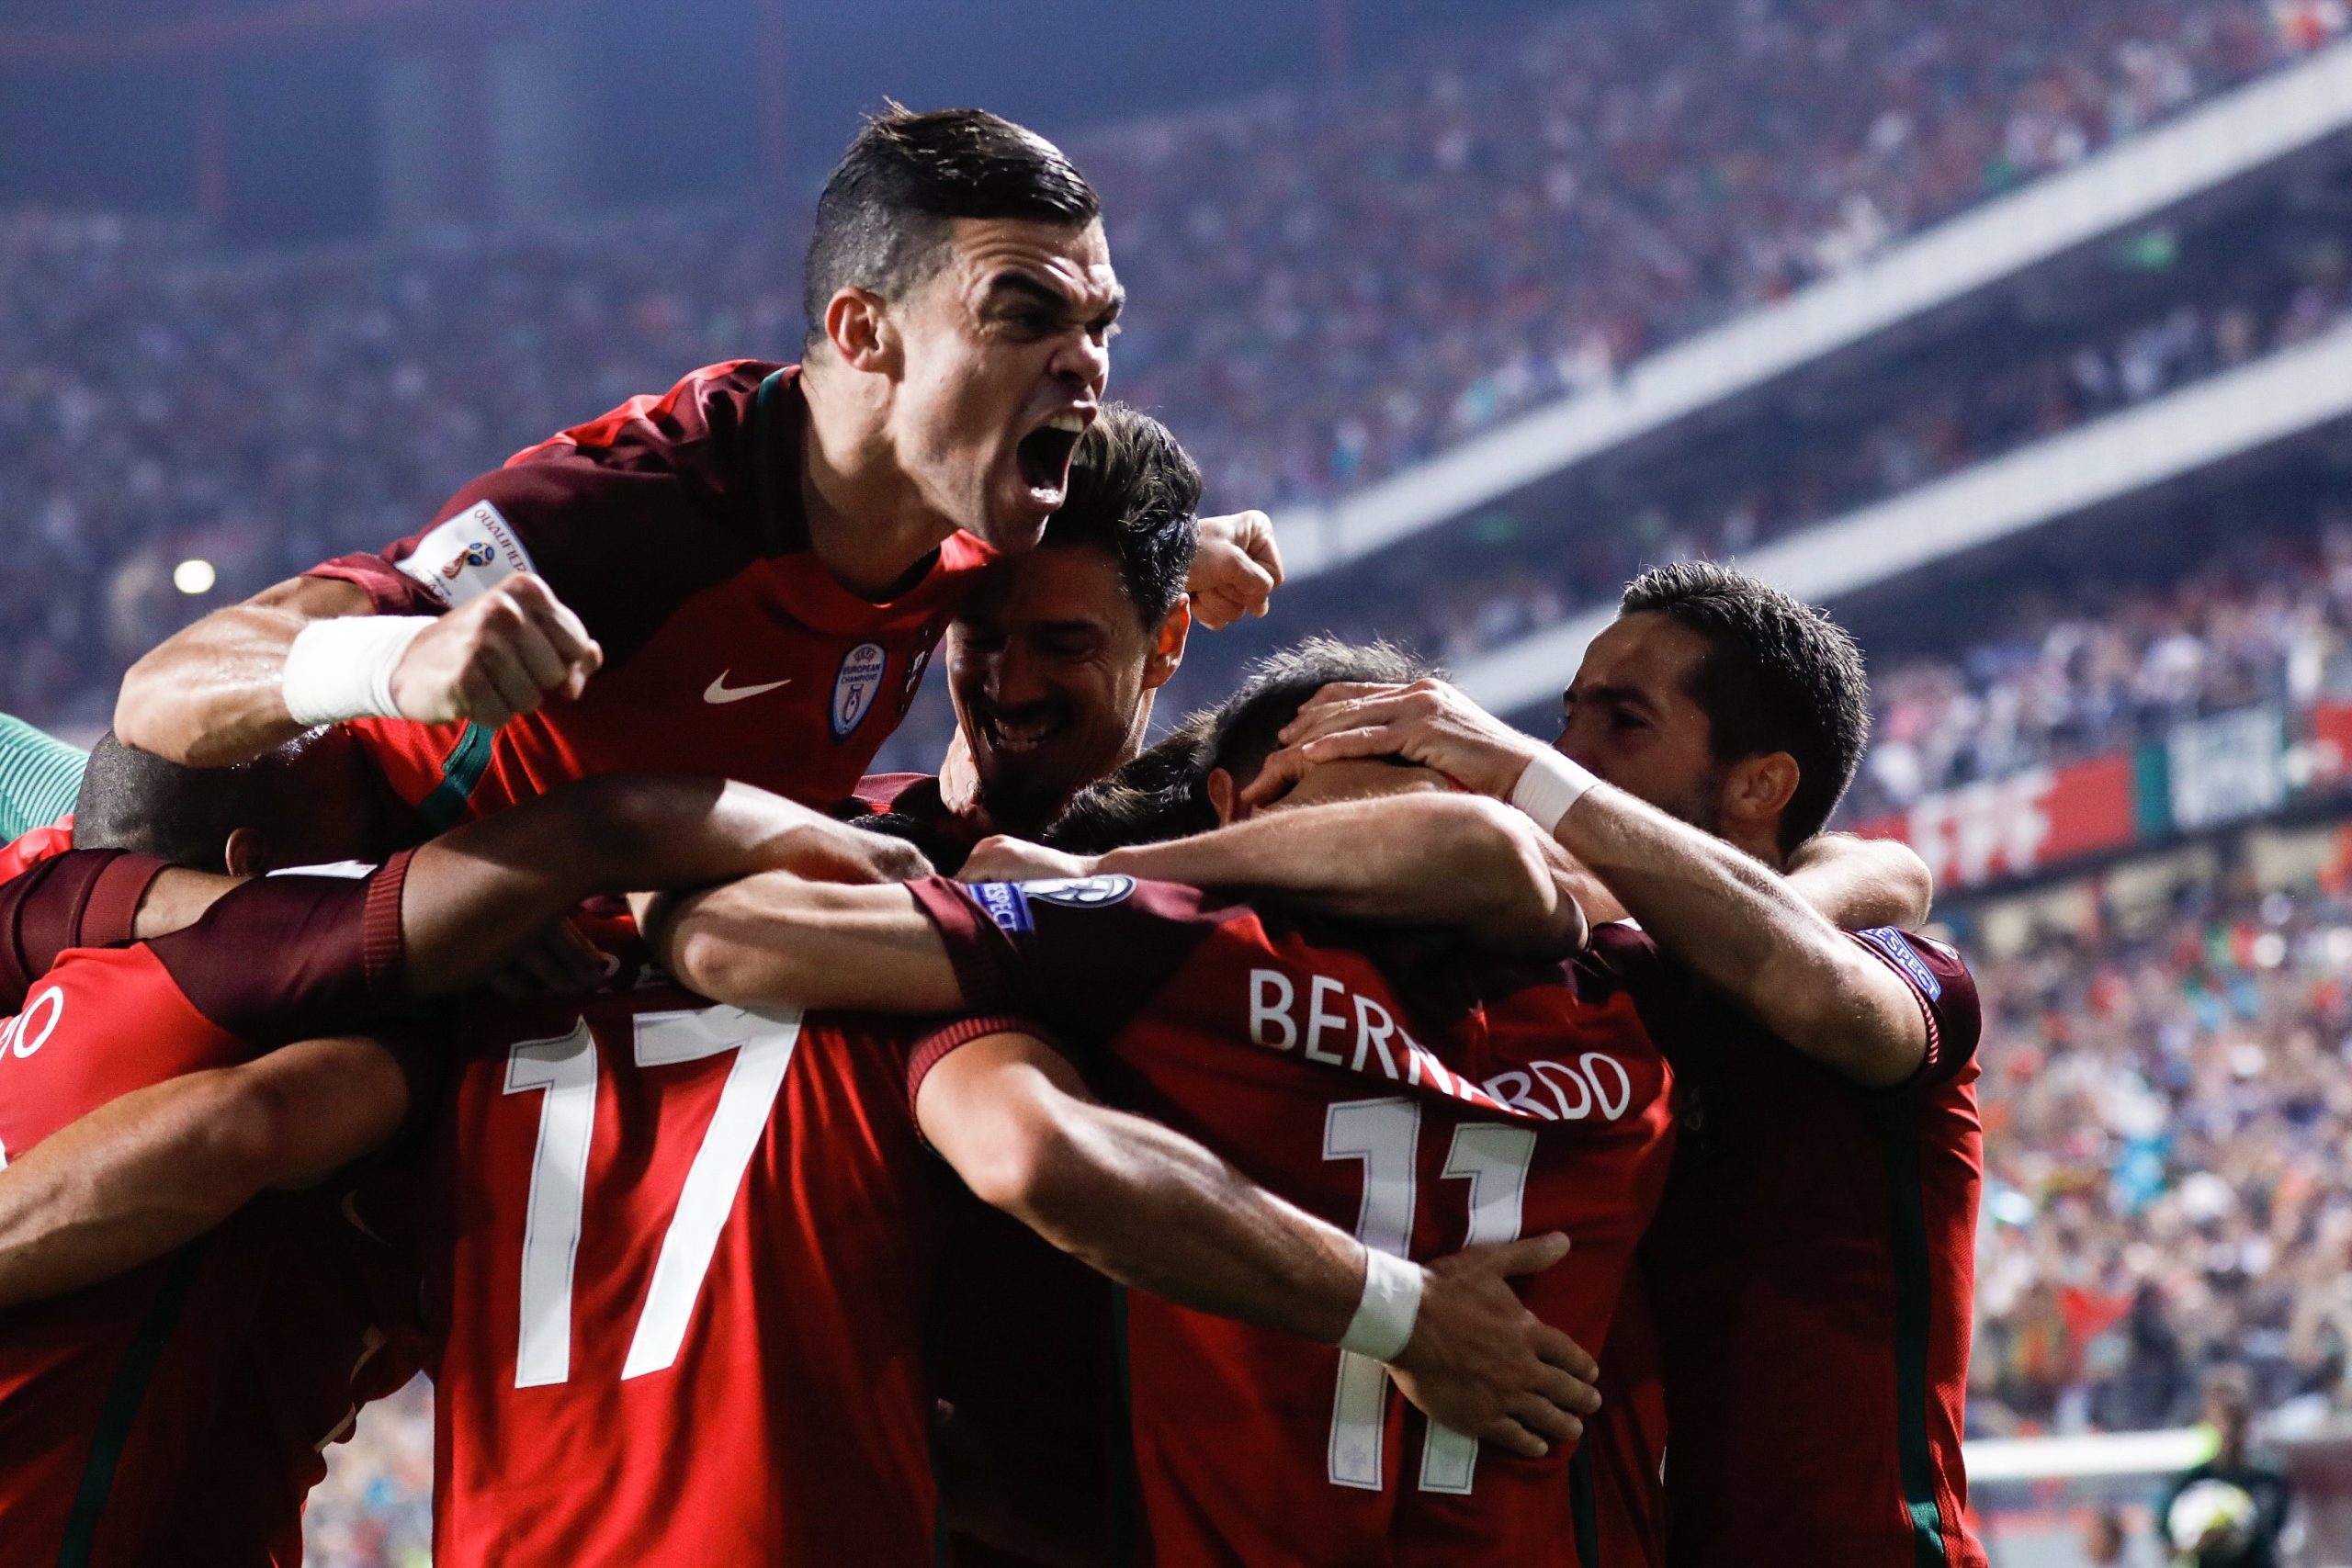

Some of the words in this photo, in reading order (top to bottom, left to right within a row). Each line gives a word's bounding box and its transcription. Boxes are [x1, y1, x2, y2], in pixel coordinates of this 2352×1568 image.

[841, 673, 877, 683] CHAMPIONS
[842, 663, 881, 674] EUROPEAN
[981, 882, 1018, 931] ESPECT
[503, 1003, 806, 1389] 17
[1322, 1096, 1538, 1495] 11
